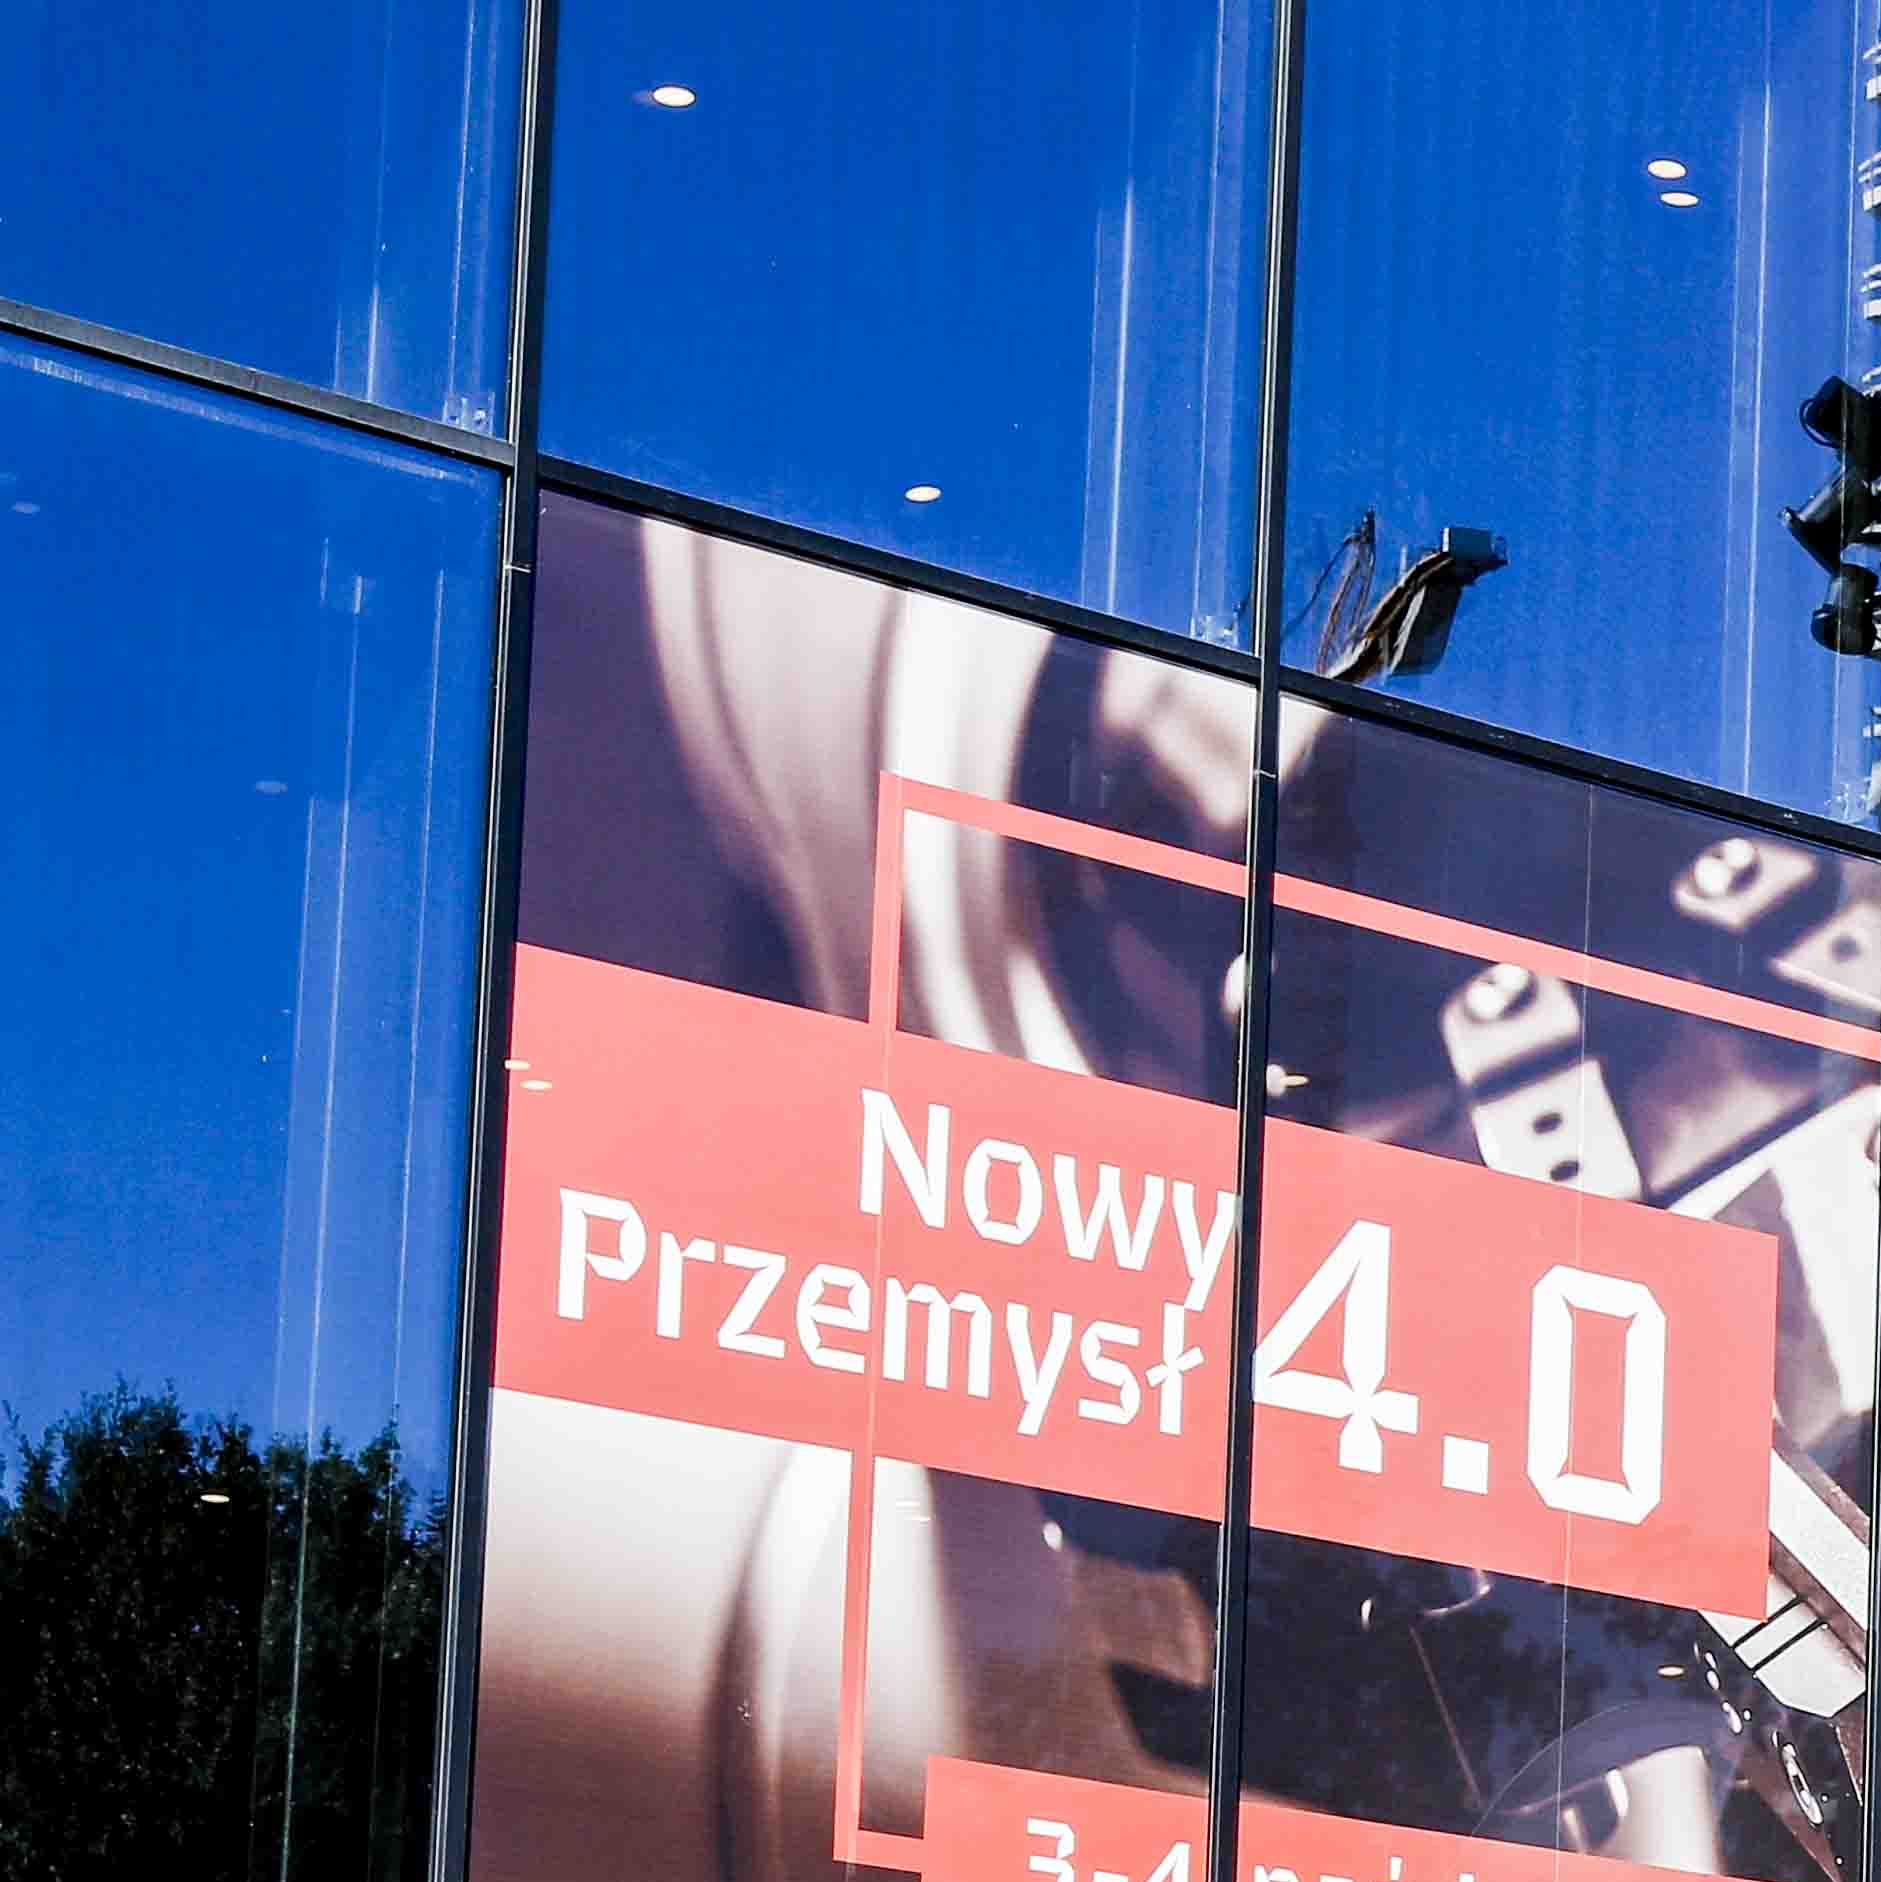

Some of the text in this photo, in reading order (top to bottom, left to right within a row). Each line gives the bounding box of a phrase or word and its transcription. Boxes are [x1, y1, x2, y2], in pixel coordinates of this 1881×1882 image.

[557, 1188, 1207, 1435] Przemysł
[860, 1087, 1236, 1312] Nowy
[1252, 1218, 1668, 1524] 4.0
